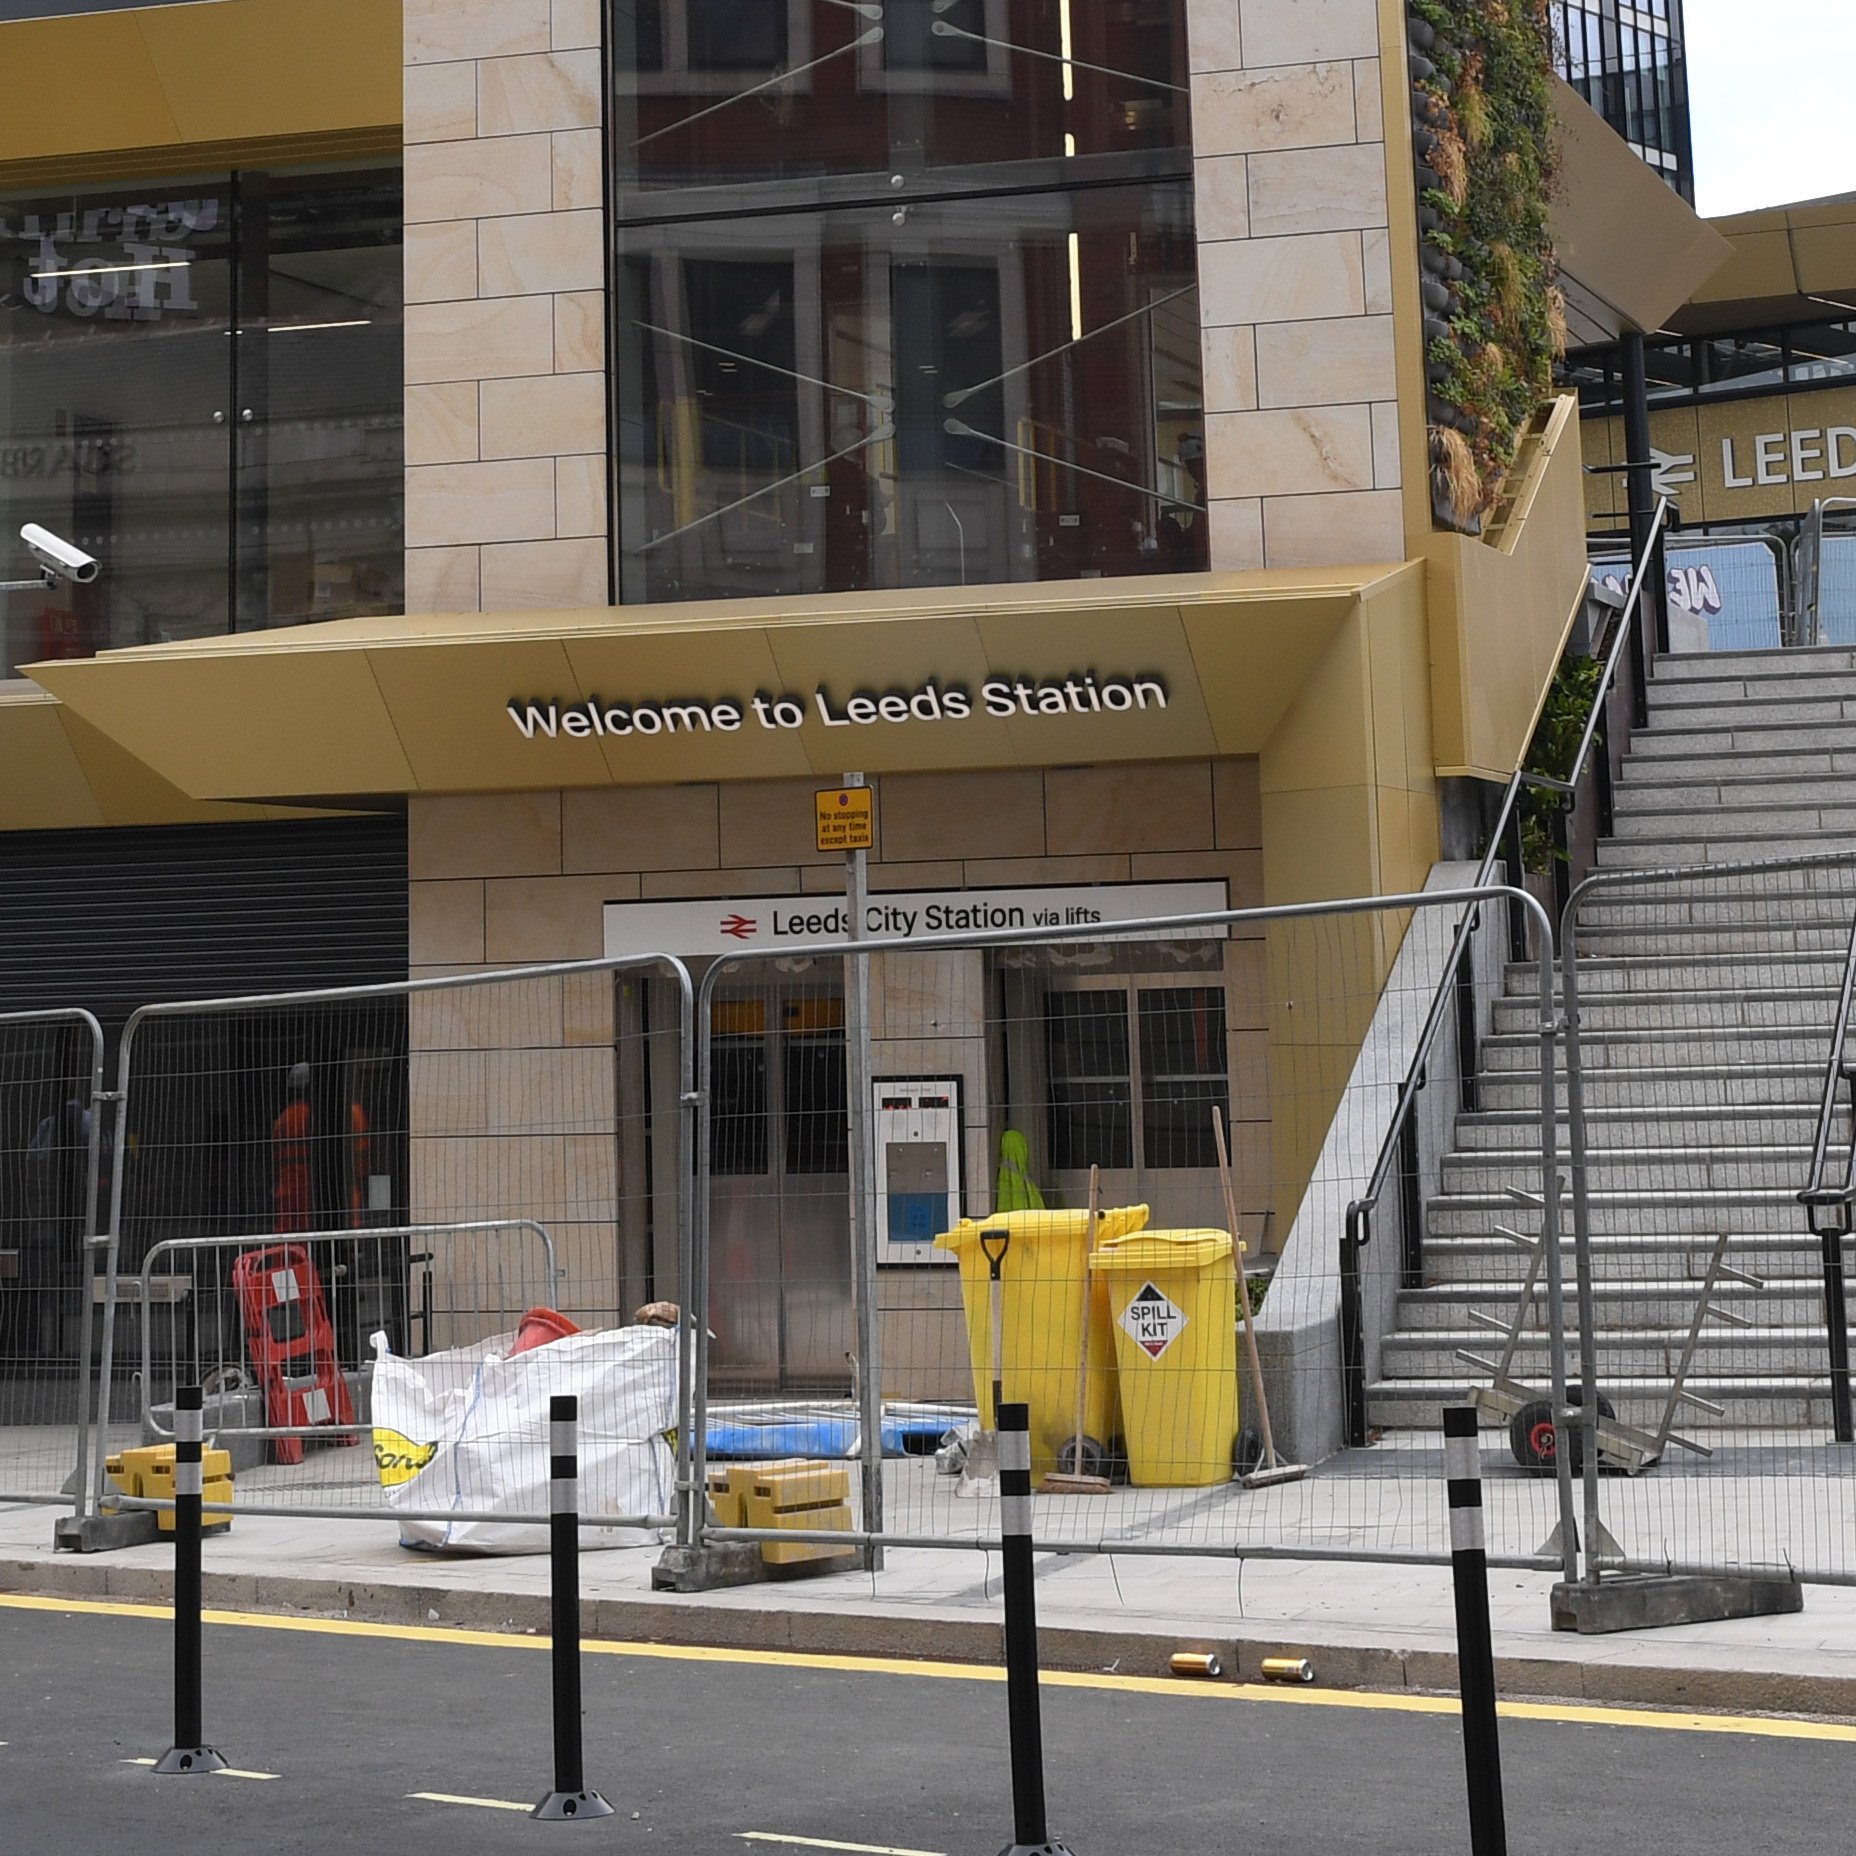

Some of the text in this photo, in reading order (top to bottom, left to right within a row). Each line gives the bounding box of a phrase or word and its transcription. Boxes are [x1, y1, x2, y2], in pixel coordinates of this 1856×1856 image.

[507, 674, 1168, 738] Welcome to Leeds Station
[820, 809, 868, 820] No stopping
[822, 822, 867, 833] at any time
[820, 833, 869, 845] except taxis
[925, 902, 1024, 930] Station
[1033, 908, 1059, 926] via
[1066, 907, 1101, 924] lifts
[1131, 1305, 1176, 1320] SPILL
[1141, 1322, 1167, 1337] KIT
